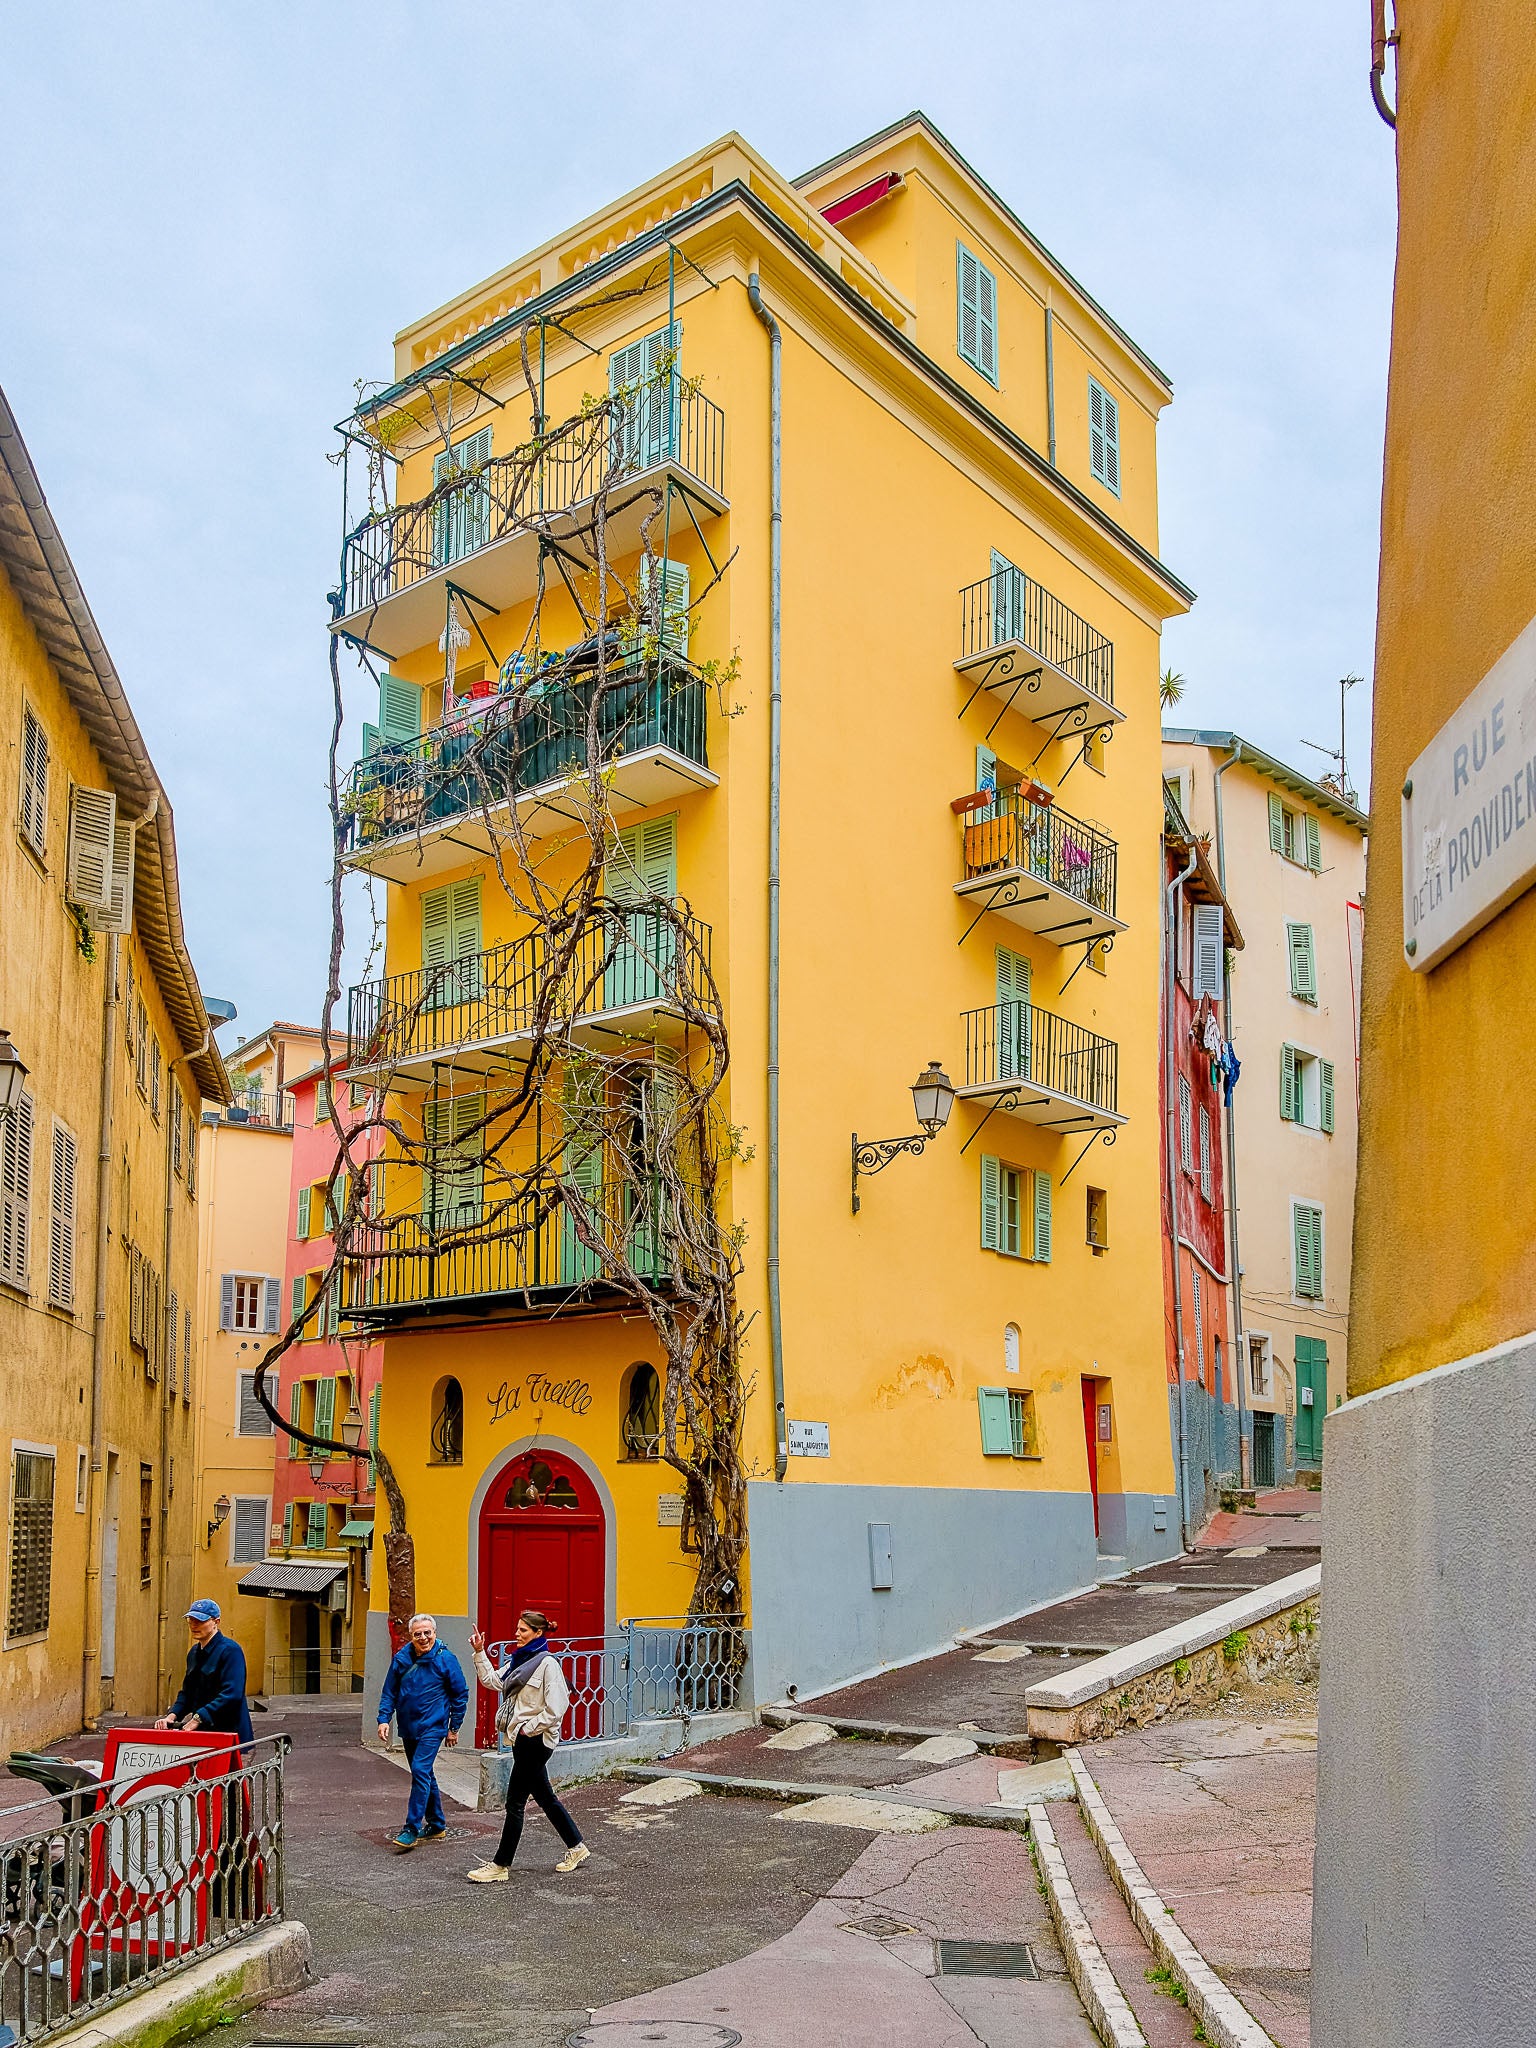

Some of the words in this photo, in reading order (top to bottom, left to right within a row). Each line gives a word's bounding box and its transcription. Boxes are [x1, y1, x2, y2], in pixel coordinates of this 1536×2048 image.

[1454, 697, 1507, 797] RUE
[1413, 887, 1425, 926] DE
[1429, 872, 1443, 911] LA
[1448, 756, 1536, 892] PROVIDEN
[487, 1381, 521, 1425] La
[525, 1373, 593, 1416] Treille
[804, 1428, 813, 1436] RUE
[807, 1442, 828, 1450] AUGUSTIN
